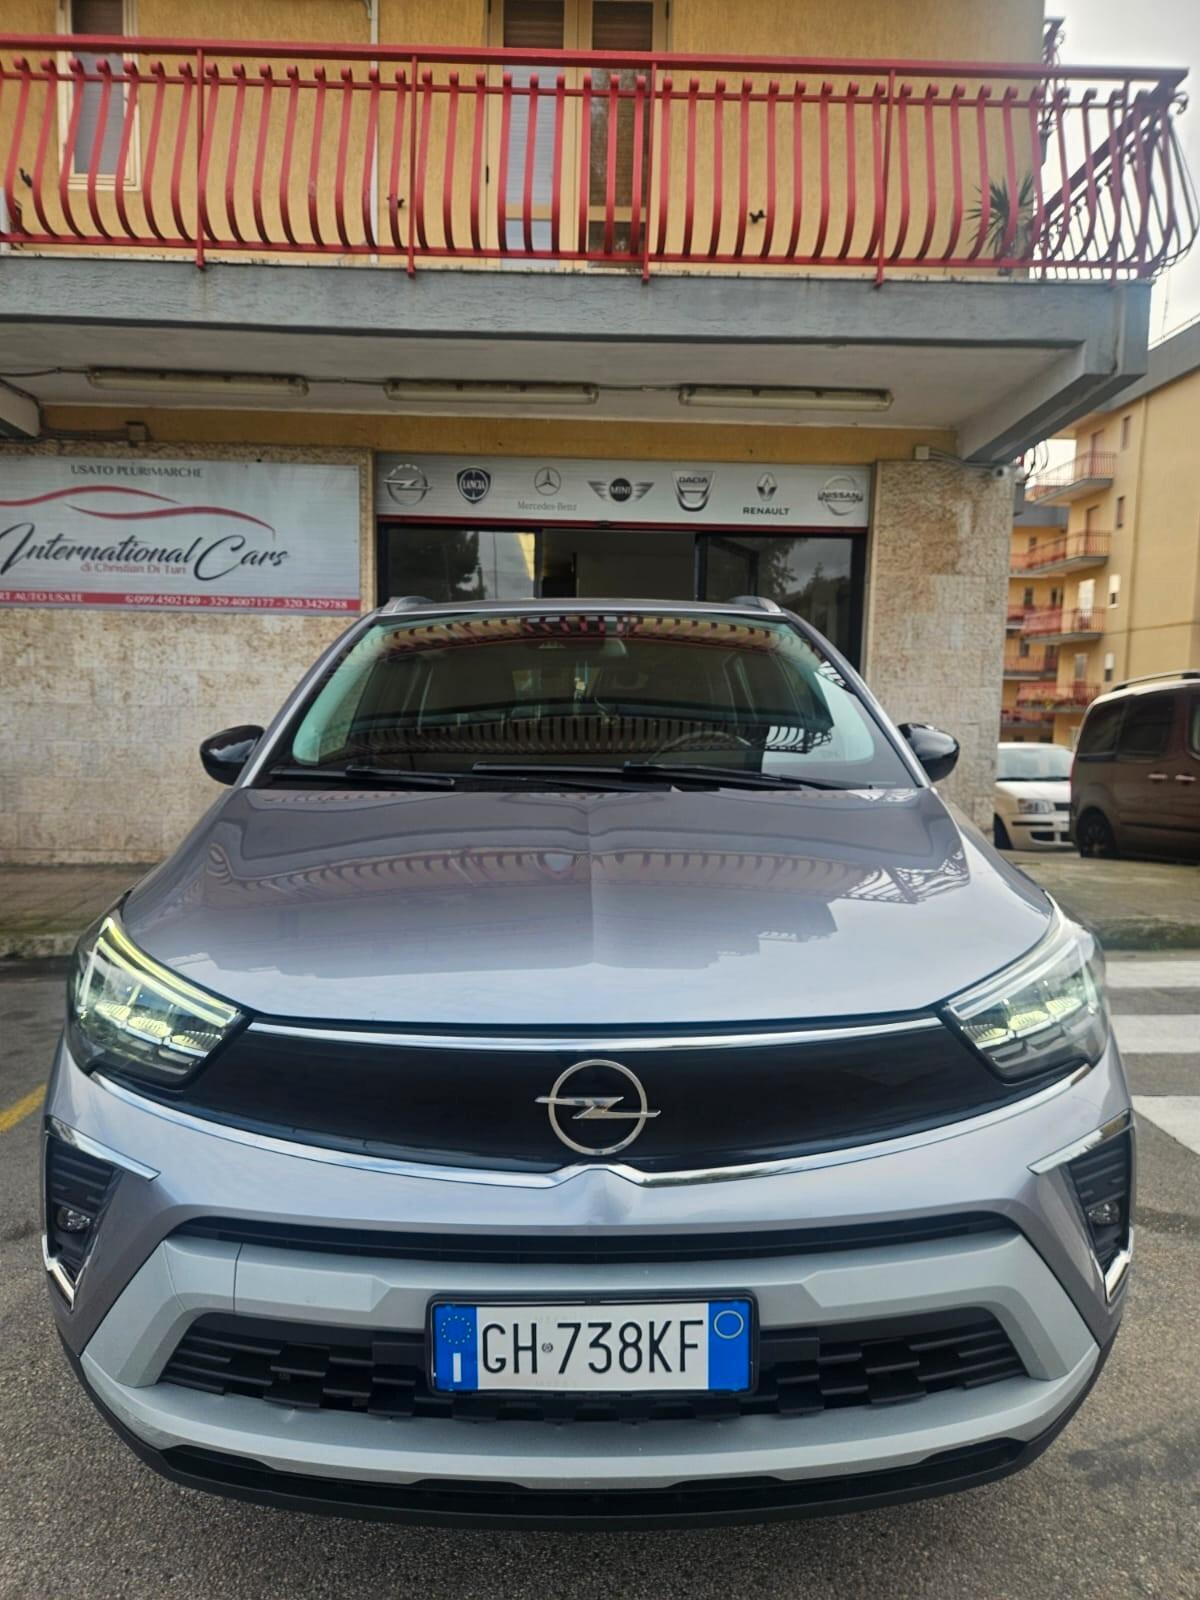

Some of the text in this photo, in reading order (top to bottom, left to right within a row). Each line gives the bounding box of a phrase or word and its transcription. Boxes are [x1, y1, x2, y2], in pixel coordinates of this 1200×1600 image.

[71, 464, 202, 478] USATO PLURIMARCHE
[462, 478, 488, 491] LANCIA
[678, 475, 708, 485] DACIA
[610, 484, 632, 496] MINI
[822, 491, 860, 502] NISSAN
[743, 506, 790, 516] RENAULT
[0, 523, 289, 581] International Cars
[15, 593, 48, 602] AUTO
[51, 593, 83, 603] USATE
[453, 1352, 462, 1383] I
